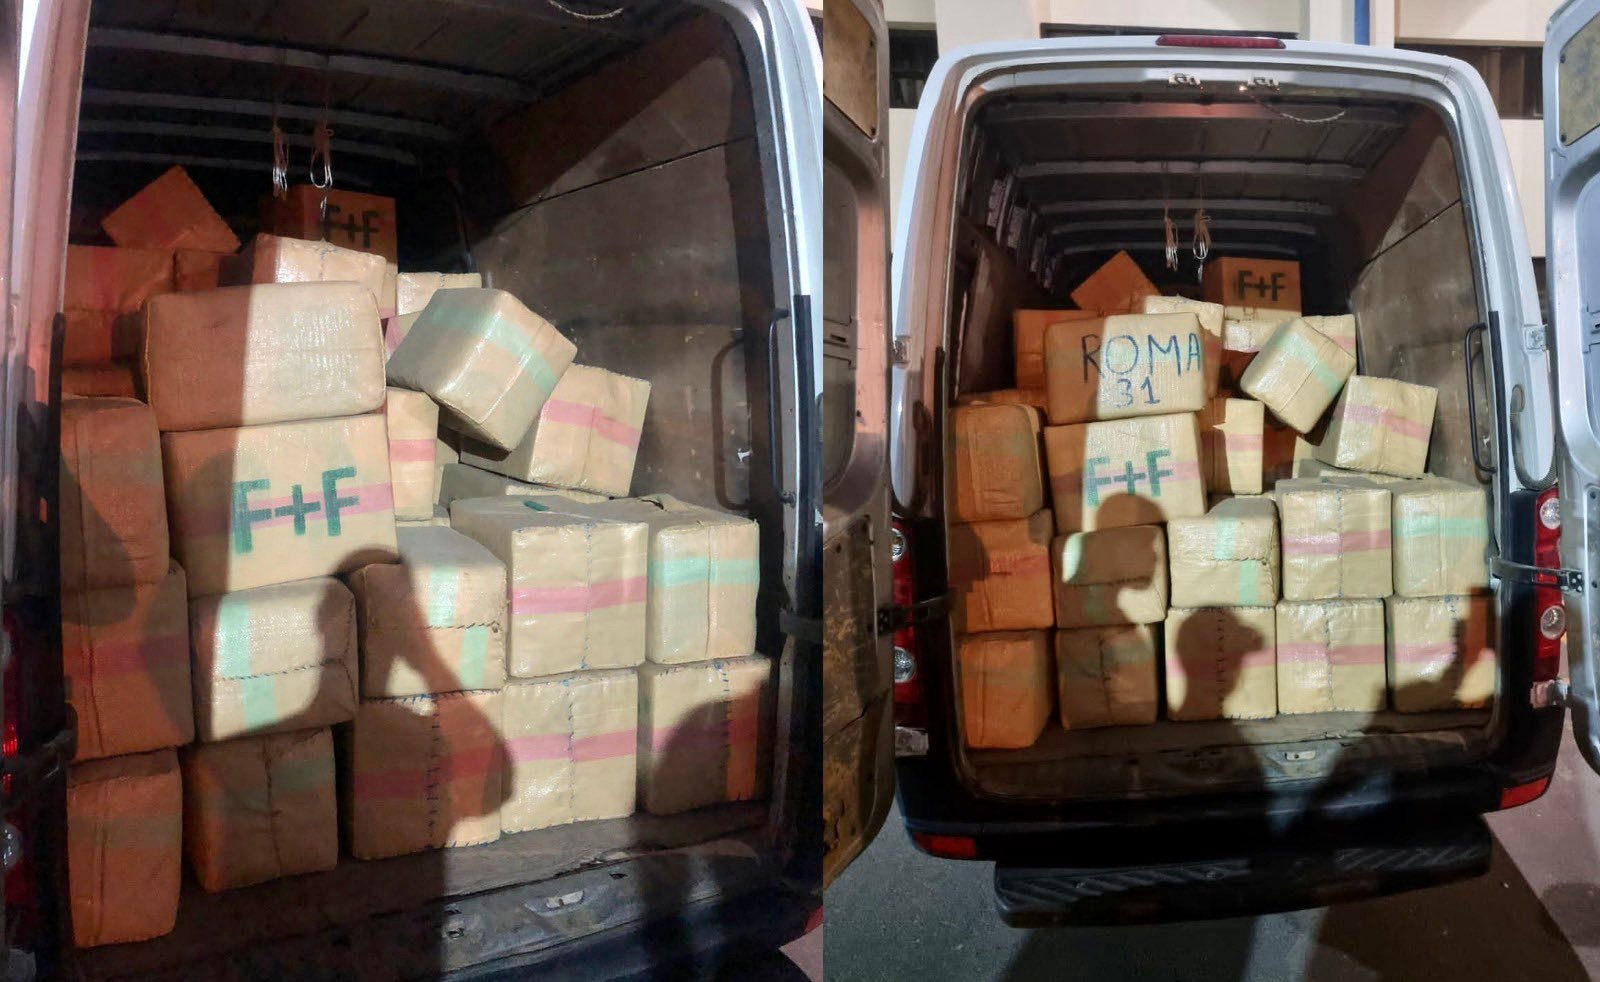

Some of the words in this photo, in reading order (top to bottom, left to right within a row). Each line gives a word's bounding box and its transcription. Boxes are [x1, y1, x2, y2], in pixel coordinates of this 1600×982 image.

[1236, 270, 1286, 302] F+F
[1081, 332, 1200, 383] ROMA
[1115, 376, 1161, 408] 31
[1085, 449, 1174, 507] F+F
[231, 466, 359, 555] F+F
